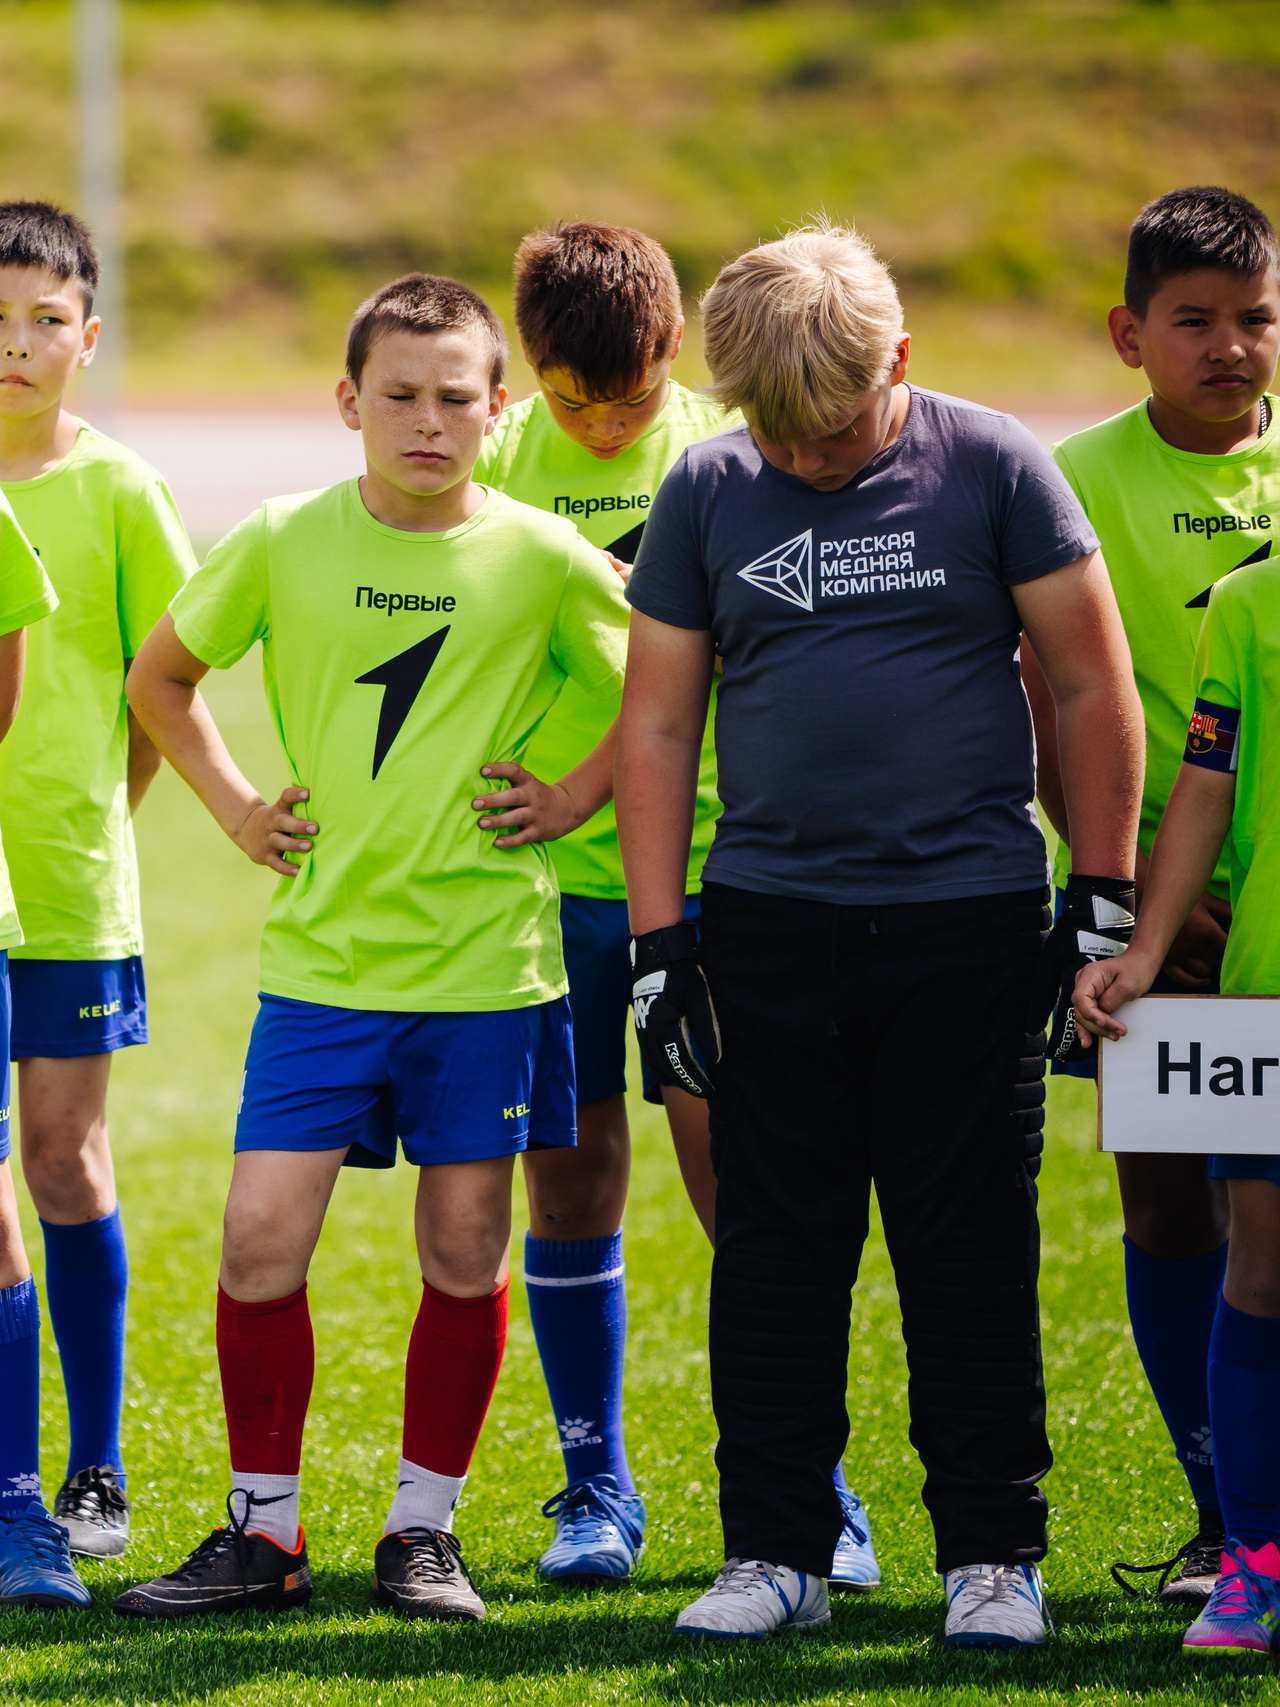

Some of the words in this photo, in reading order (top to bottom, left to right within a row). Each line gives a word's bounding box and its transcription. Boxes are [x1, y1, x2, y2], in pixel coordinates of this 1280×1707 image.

[554, 494, 651, 520] Первые
[1173, 513, 1272, 540] Первые
[820, 531, 916, 558] РУССКАЯ
[820, 551, 914, 578] МЕДНАЯ
[820, 568, 947, 597] КОМПАНИЯ
[355, 586, 456, 617] Первые
[664, 1042, 703, 1094] Kappa
[1157, 1041, 1280, 1097] Наг
